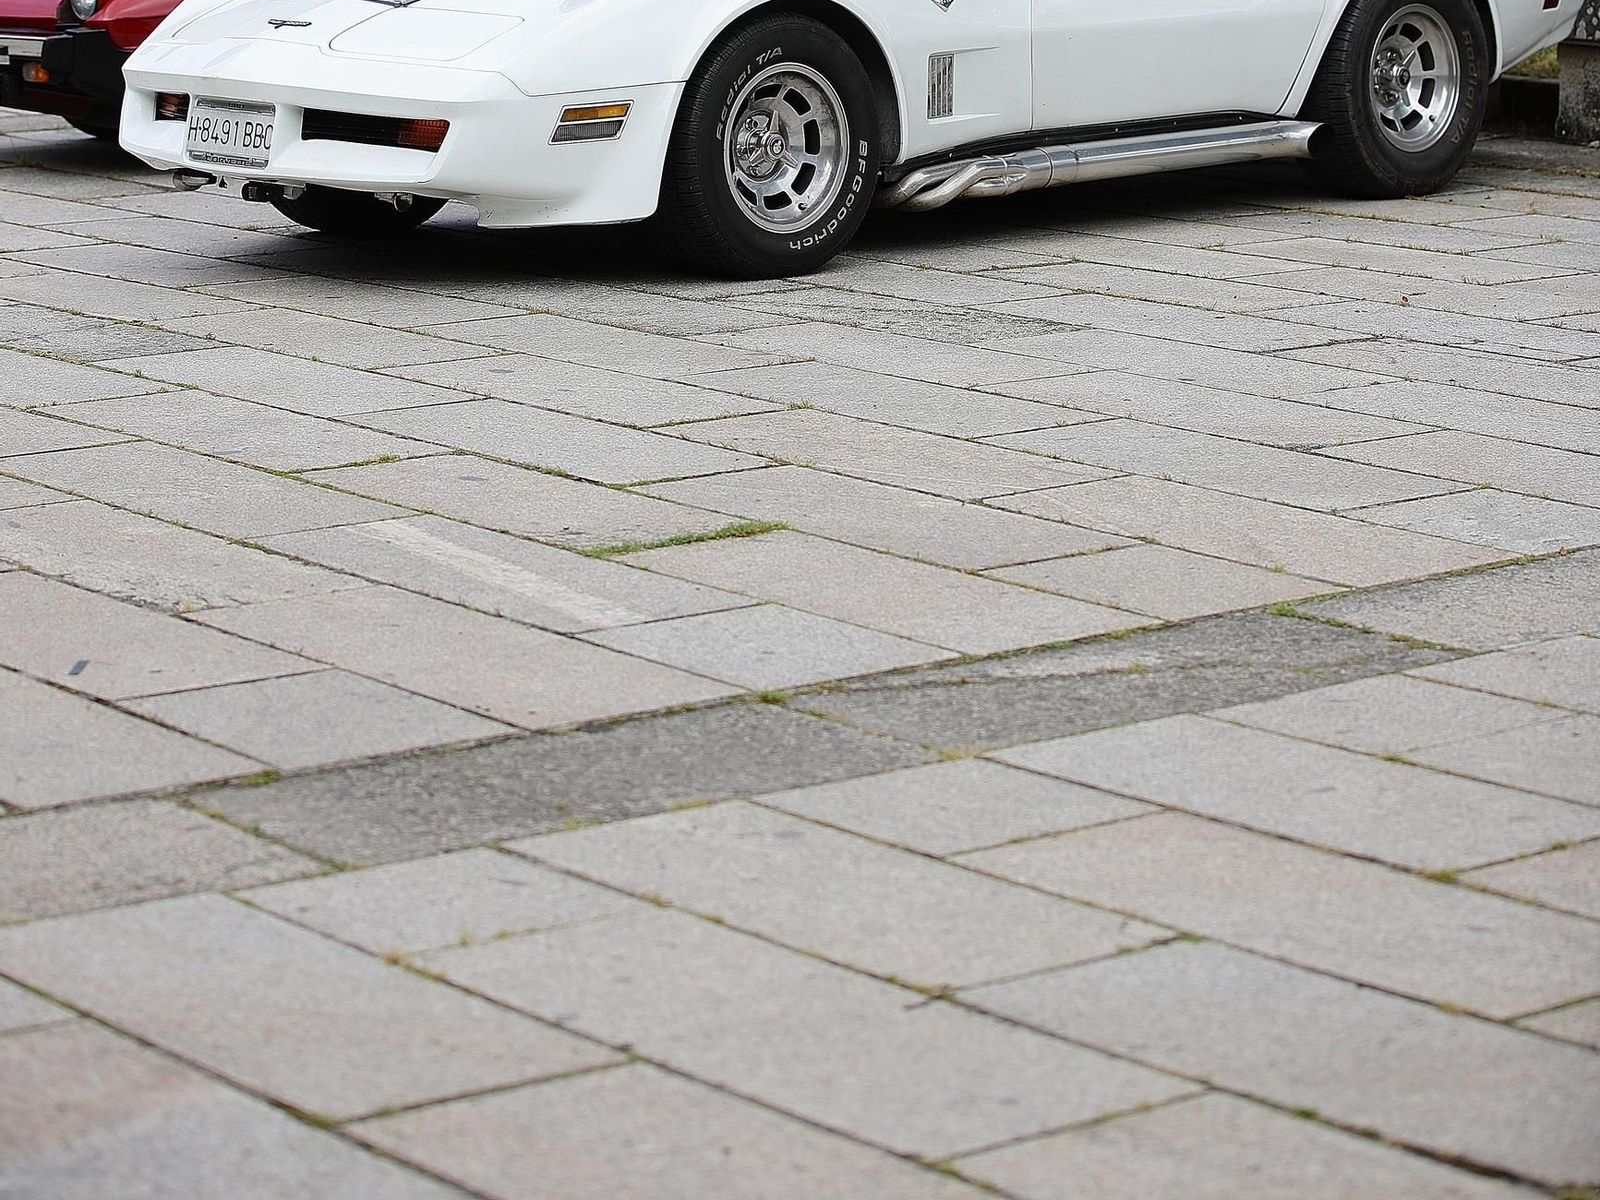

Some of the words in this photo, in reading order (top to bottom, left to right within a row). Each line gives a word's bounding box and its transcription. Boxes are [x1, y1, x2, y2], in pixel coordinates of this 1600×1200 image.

[716, 64, 751, 140] Radial
[756, 46, 783, 65] T/A
[1462, 30, 1478, 109] Radial
[789, 139, 868, 250] BFGoodrich
